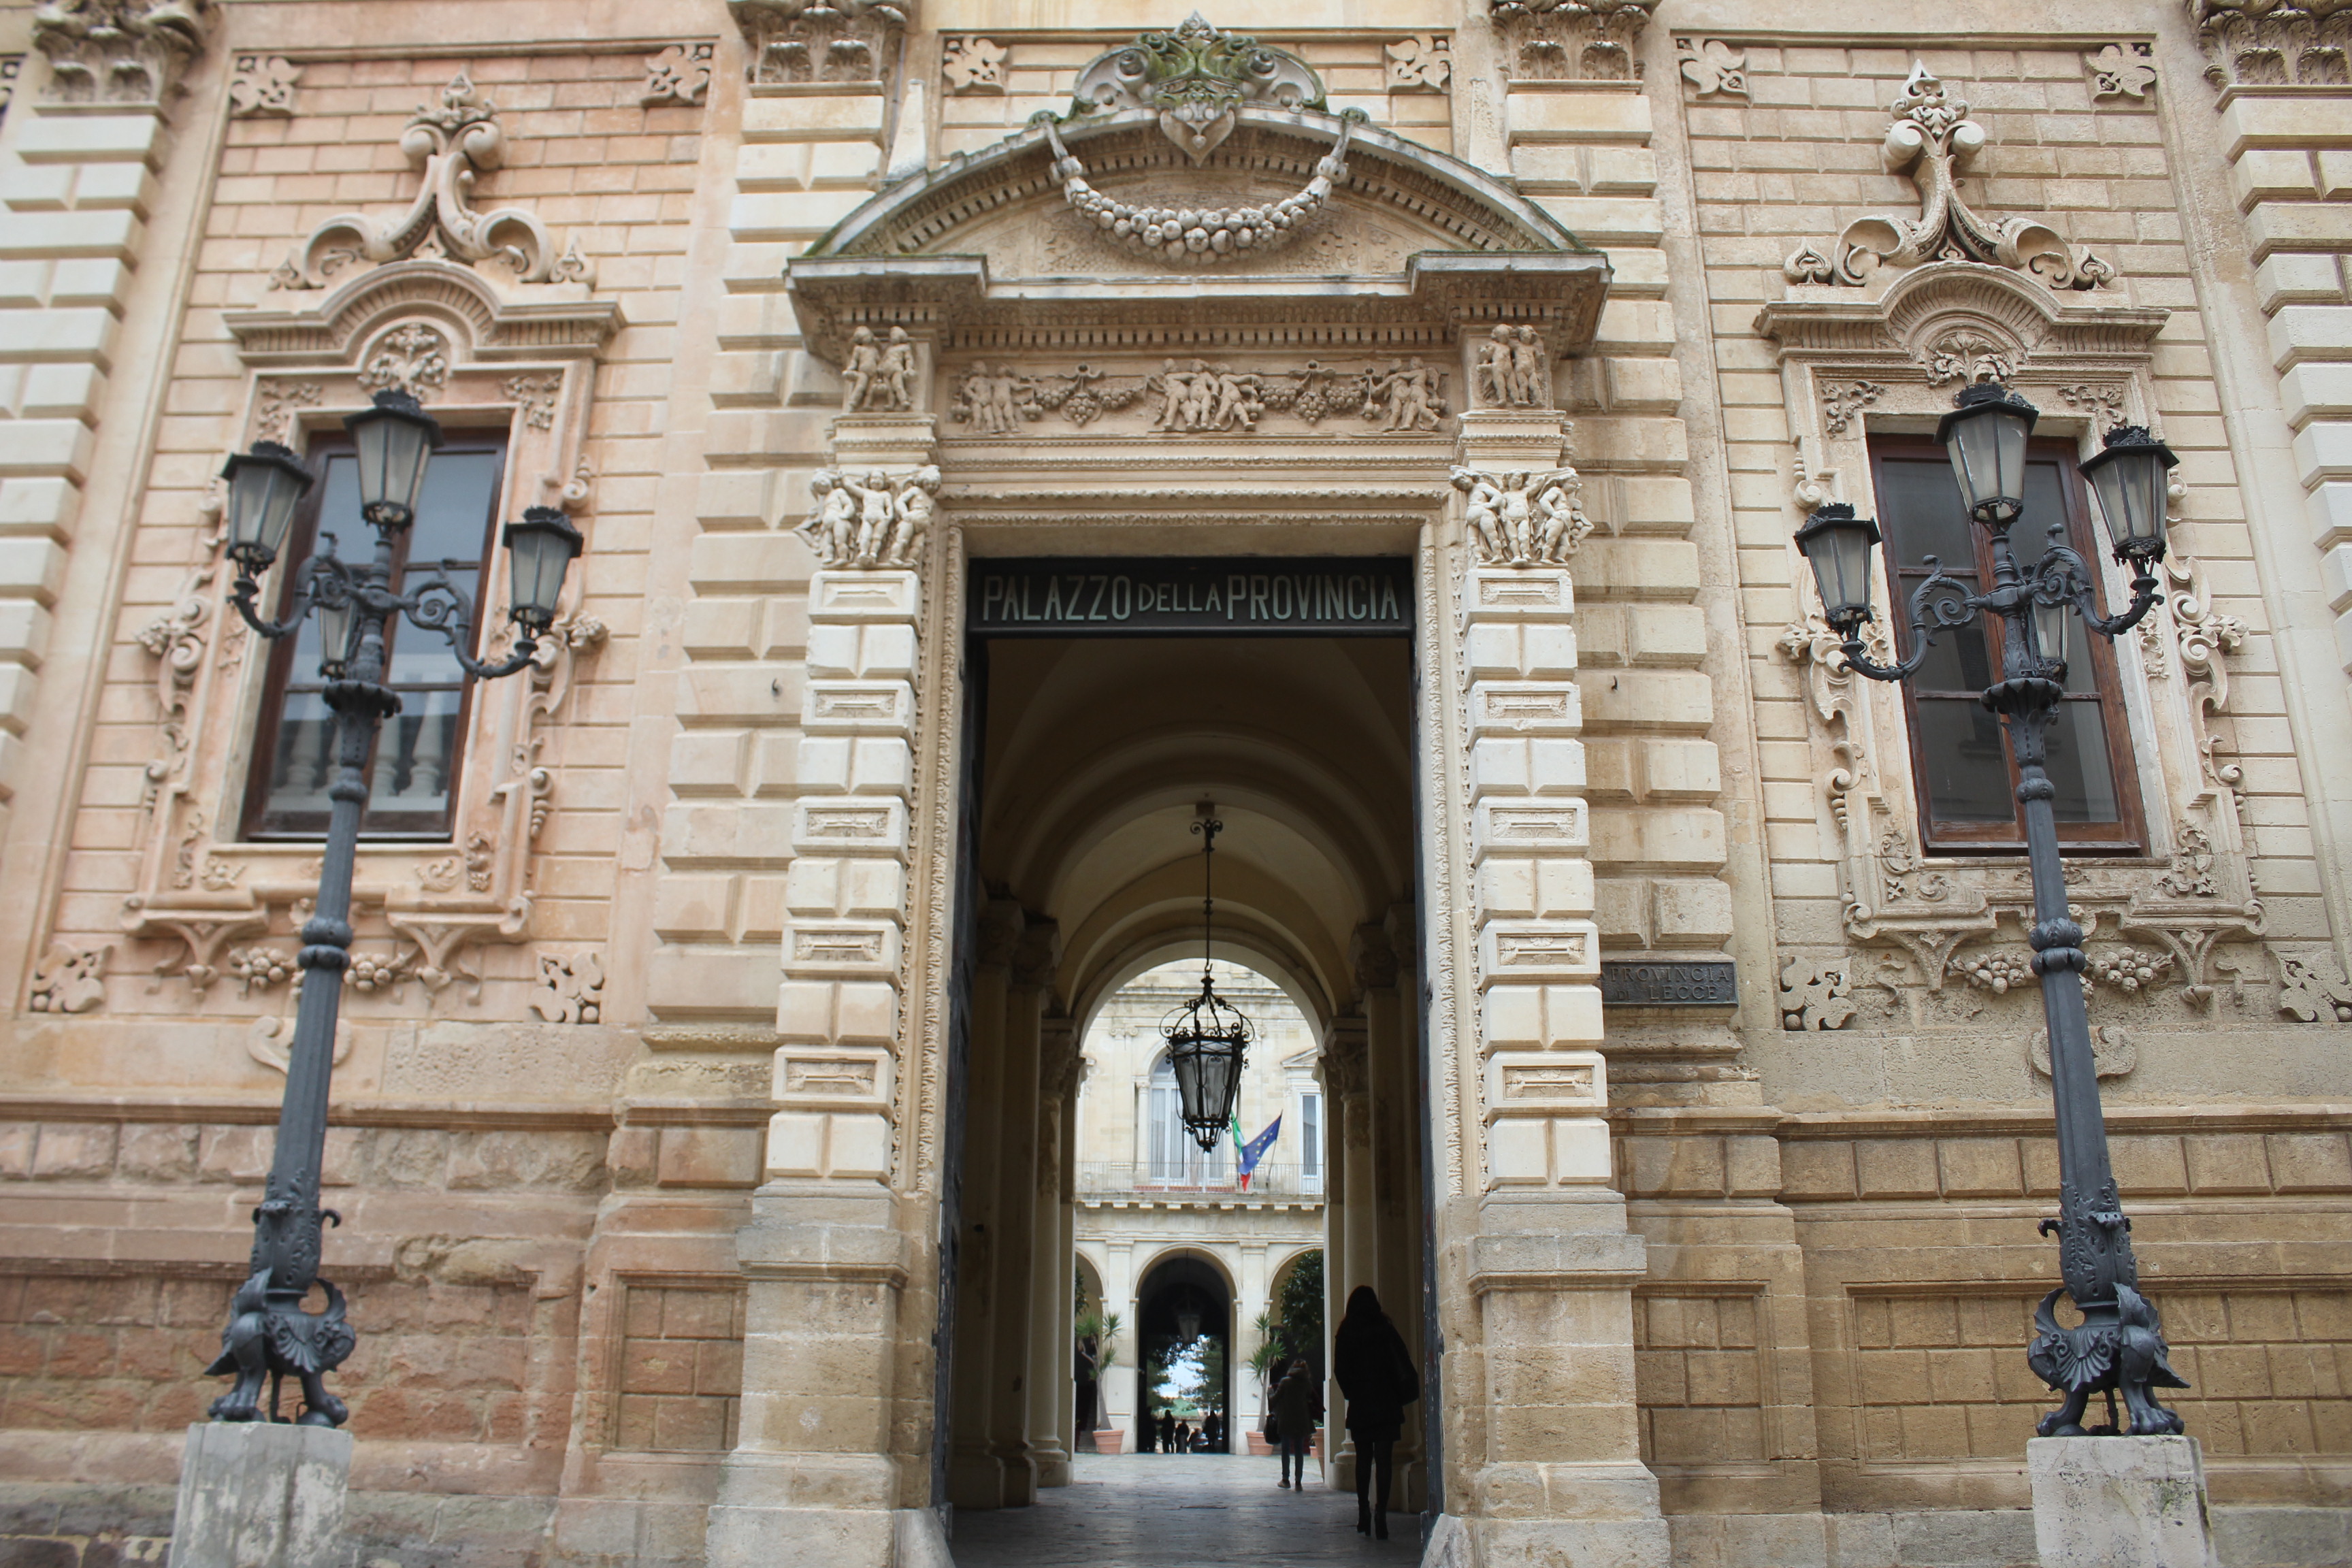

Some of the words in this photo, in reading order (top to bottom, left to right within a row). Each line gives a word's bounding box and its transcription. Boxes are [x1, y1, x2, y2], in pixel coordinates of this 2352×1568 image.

[983, 574, 1132, 621] PALAZZO
[1138, 583, 1222, 612] DELLA
[1227, 574, 1400, 621] PROVINCIA
[1610, 967, 1730, 982] PROVINCIA
[1617, 990, 1632, 1000] DI
[1648, 985, 1718, 1000] LECCE
